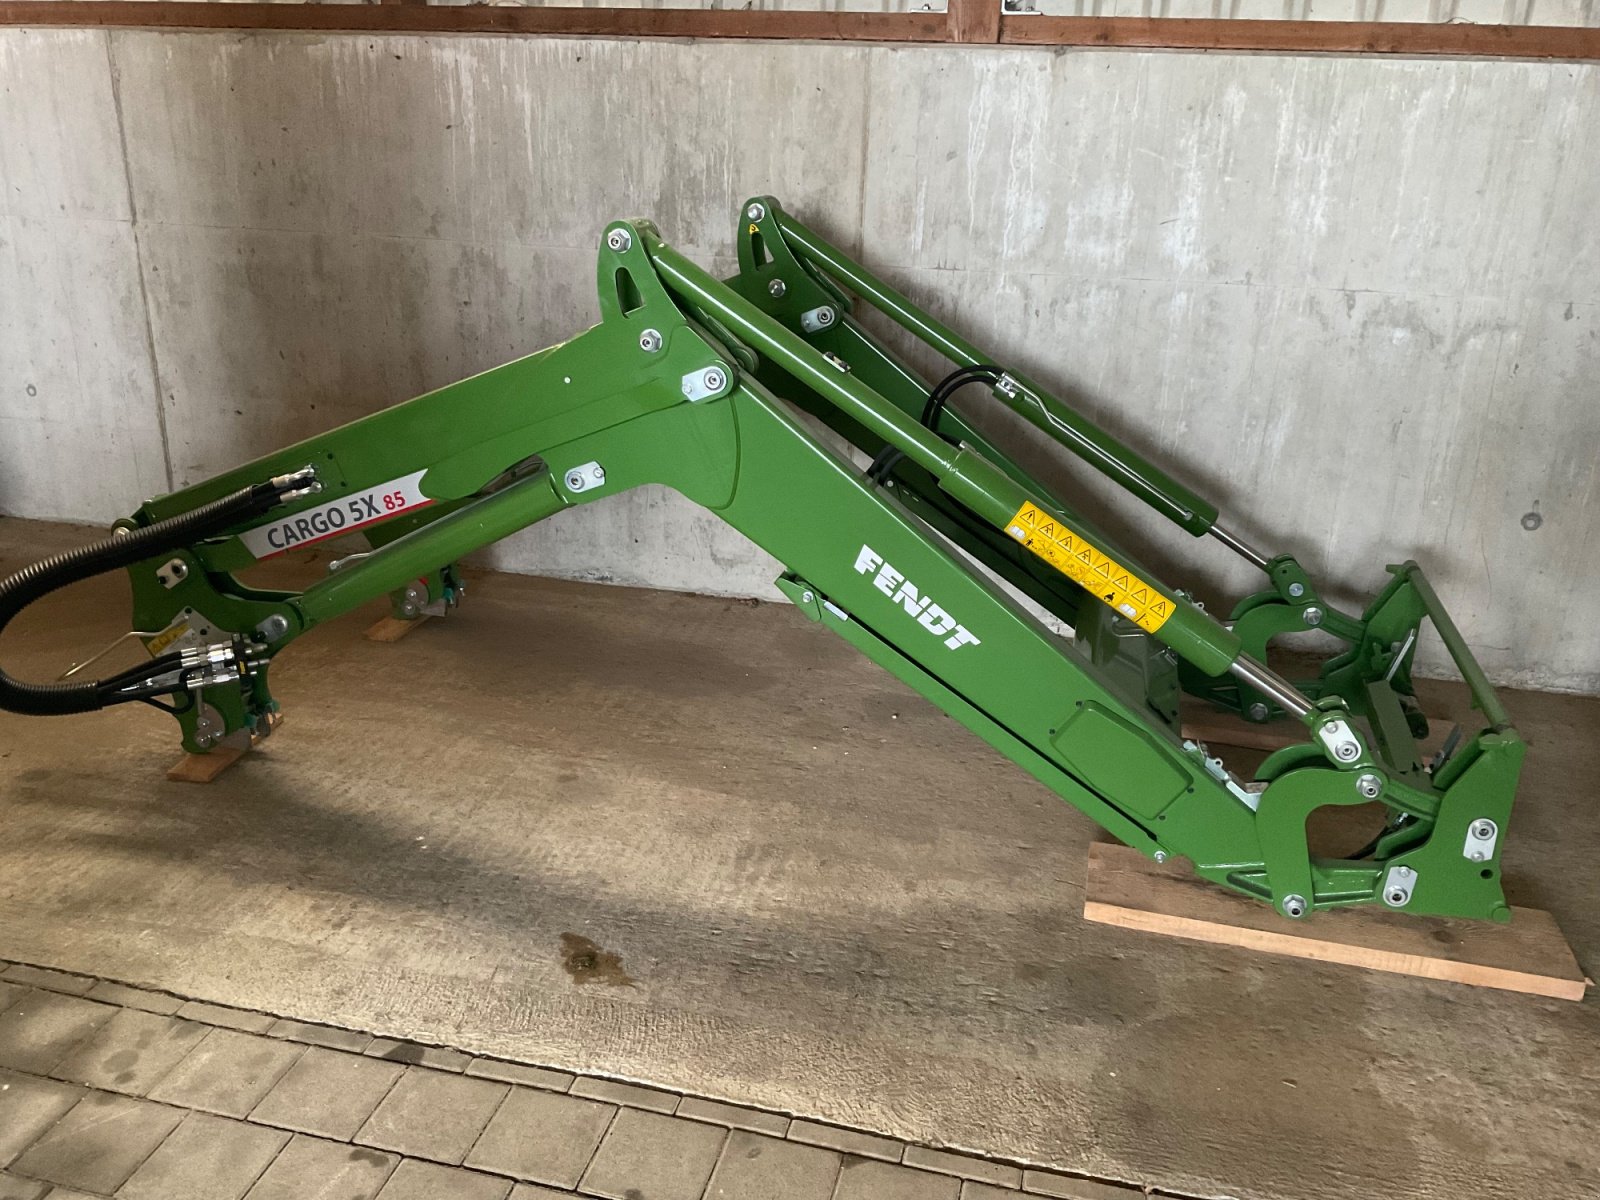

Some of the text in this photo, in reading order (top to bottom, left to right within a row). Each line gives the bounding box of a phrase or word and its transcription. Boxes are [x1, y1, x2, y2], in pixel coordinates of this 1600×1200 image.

[267, 491, 406, 548] CARGO 5X 85
[853, 544, 981, 650] FENDT
